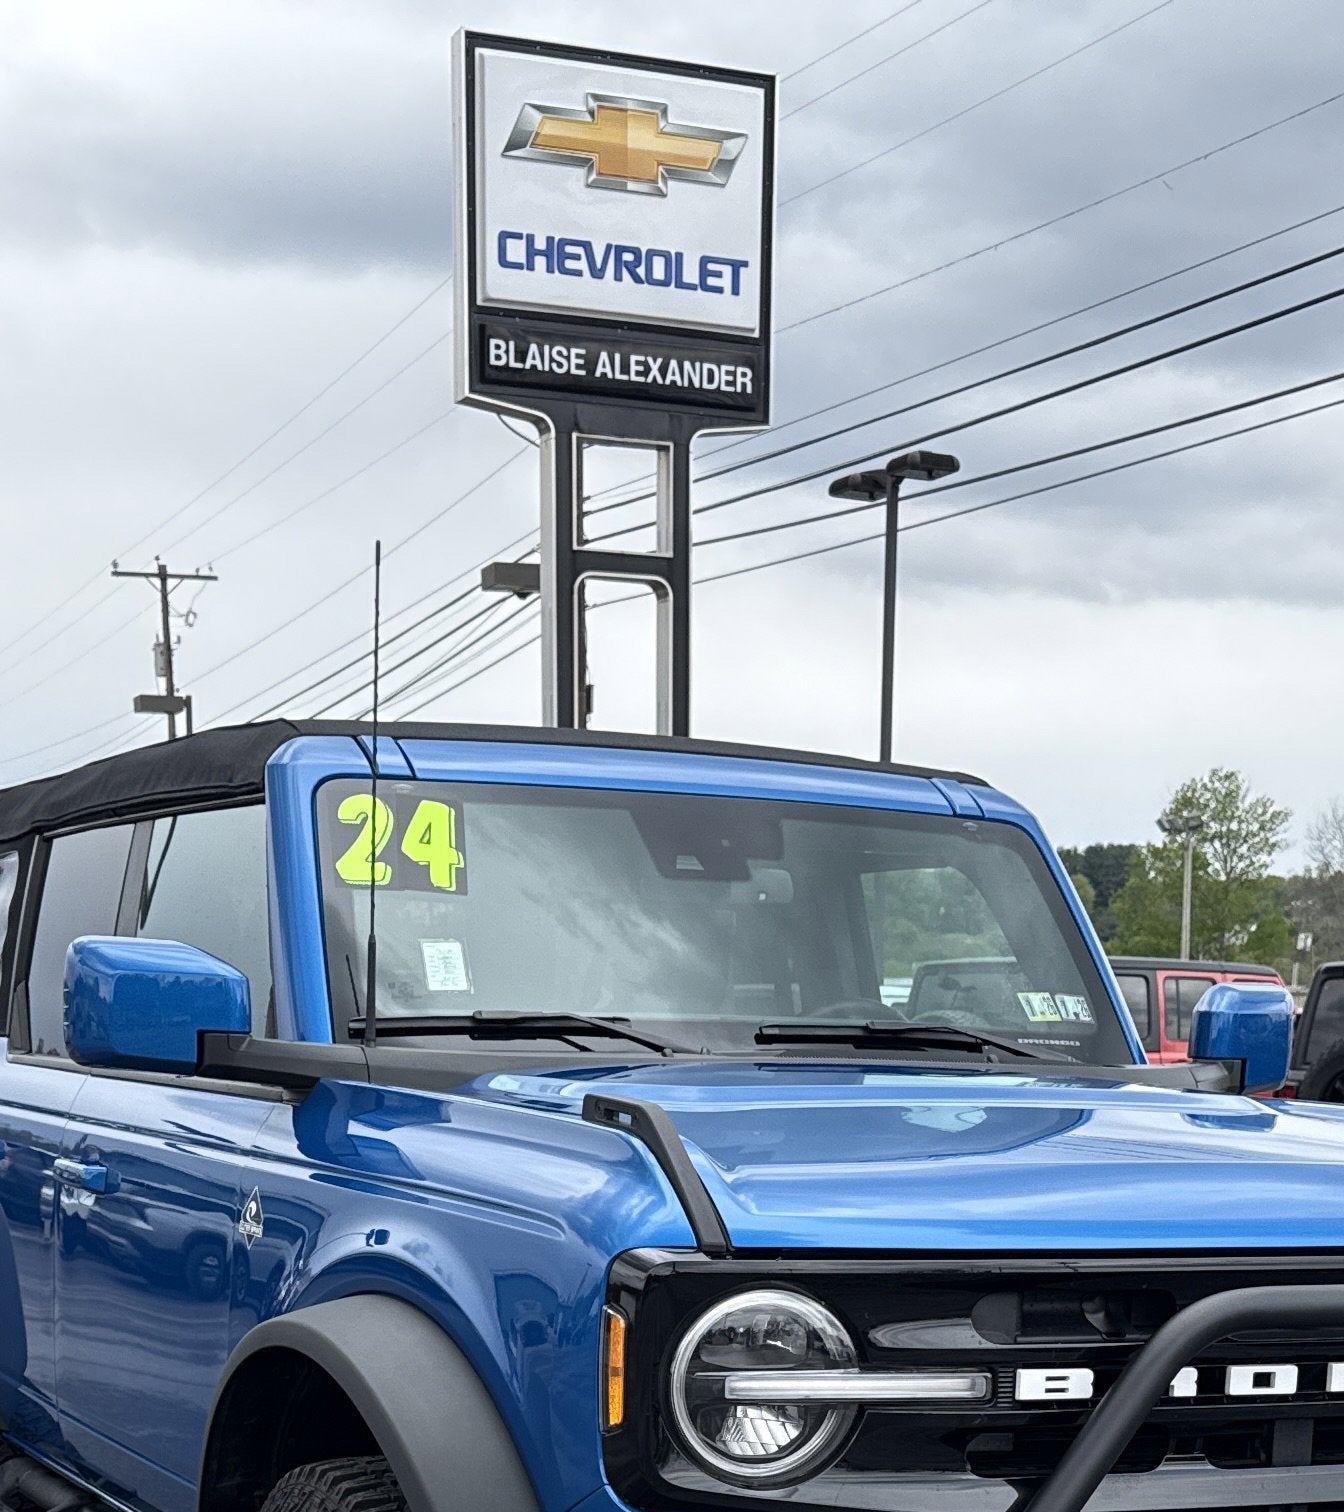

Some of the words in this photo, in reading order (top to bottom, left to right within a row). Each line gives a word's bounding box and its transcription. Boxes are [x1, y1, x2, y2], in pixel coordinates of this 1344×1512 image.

[497, 229, 750, 297] CHEVROLET
[488, 337, 588, 377] BLAISE
[594, 350, 754, 395] ALEXANDER
[335, 793, 465, 892] 24
